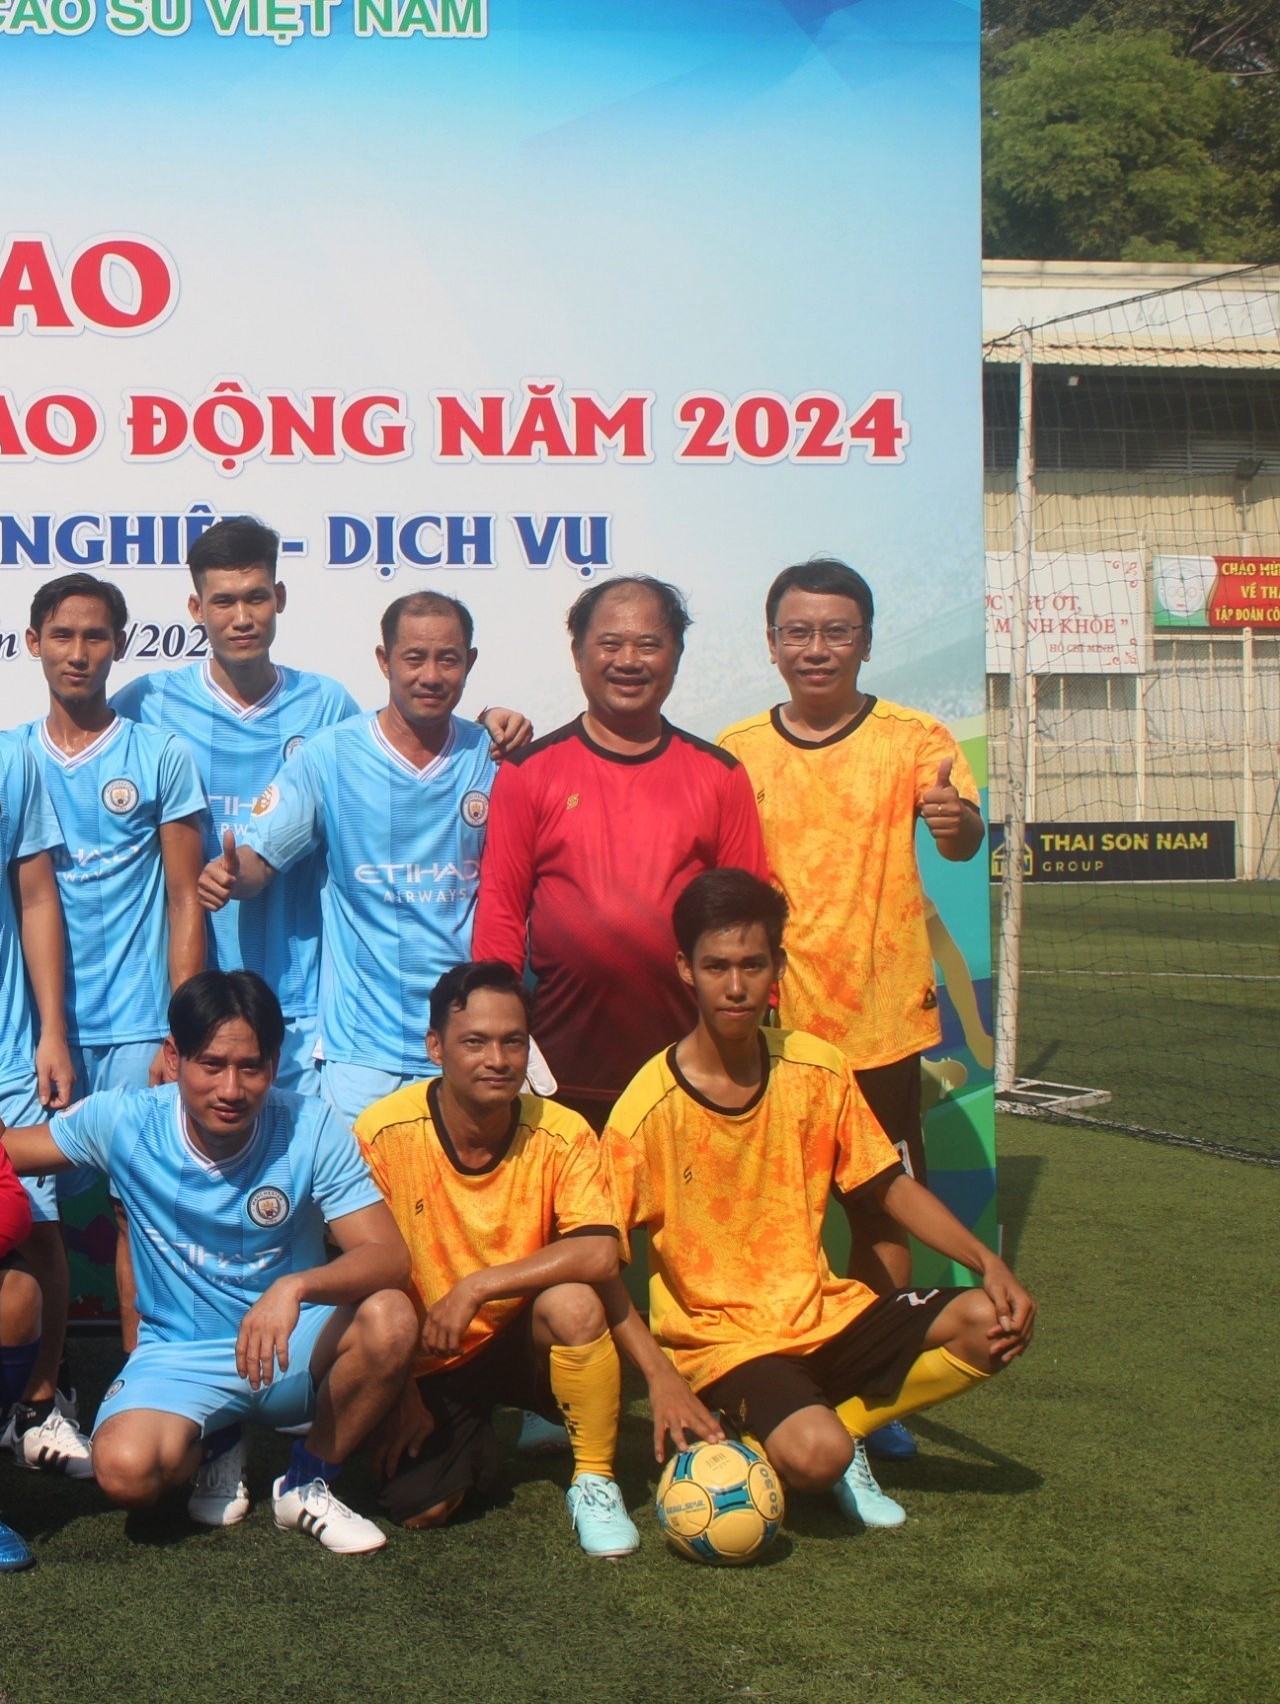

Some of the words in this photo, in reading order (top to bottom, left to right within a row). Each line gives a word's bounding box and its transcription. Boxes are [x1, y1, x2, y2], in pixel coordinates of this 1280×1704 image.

[109, 0, 187, 31] SU
[357, 0, 482, 33] NAM
[127, 381, 406, 471] ĐỘNG
[436, 383, 648, 458] NĂM
[679, 396, 904, 459] 2024
[329, 515, 493, 577] DỊCH
[516, 515, 608, 577] VỤ
[995, 618, 1054, 634] MNH
[1040, 833, 1095, 852] THAI
[1156, 832, 1209, 850] NAM
[353, 860, 480, 885] ETIHAD
[1042, 860, 1104, 872] GROUP
[383, 887, 468, 904] AIRWAYS
